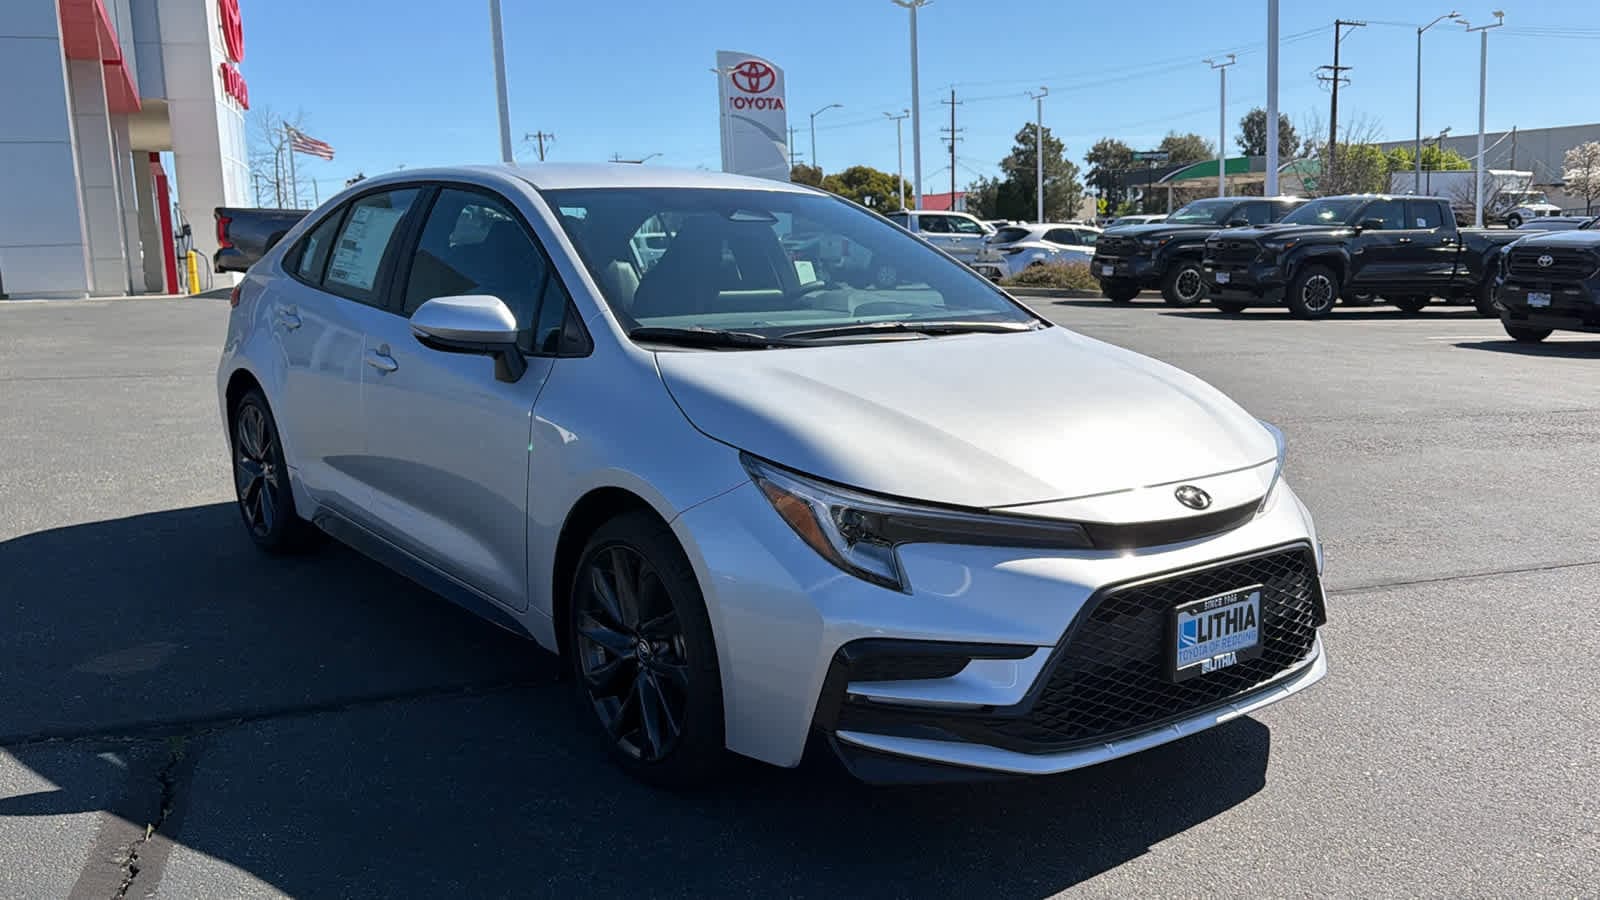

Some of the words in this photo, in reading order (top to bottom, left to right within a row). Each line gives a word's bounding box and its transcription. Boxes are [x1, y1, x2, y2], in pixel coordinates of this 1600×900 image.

[1197, 604, 1257, 643] LITHIA
[1179, 644, 1208, 662] TOYOTA
[1209, 639, 1221, 653] OF
[1221, 630, 1258, 650] REDDING
[1209, 651, 1237, 671] LITHIA
